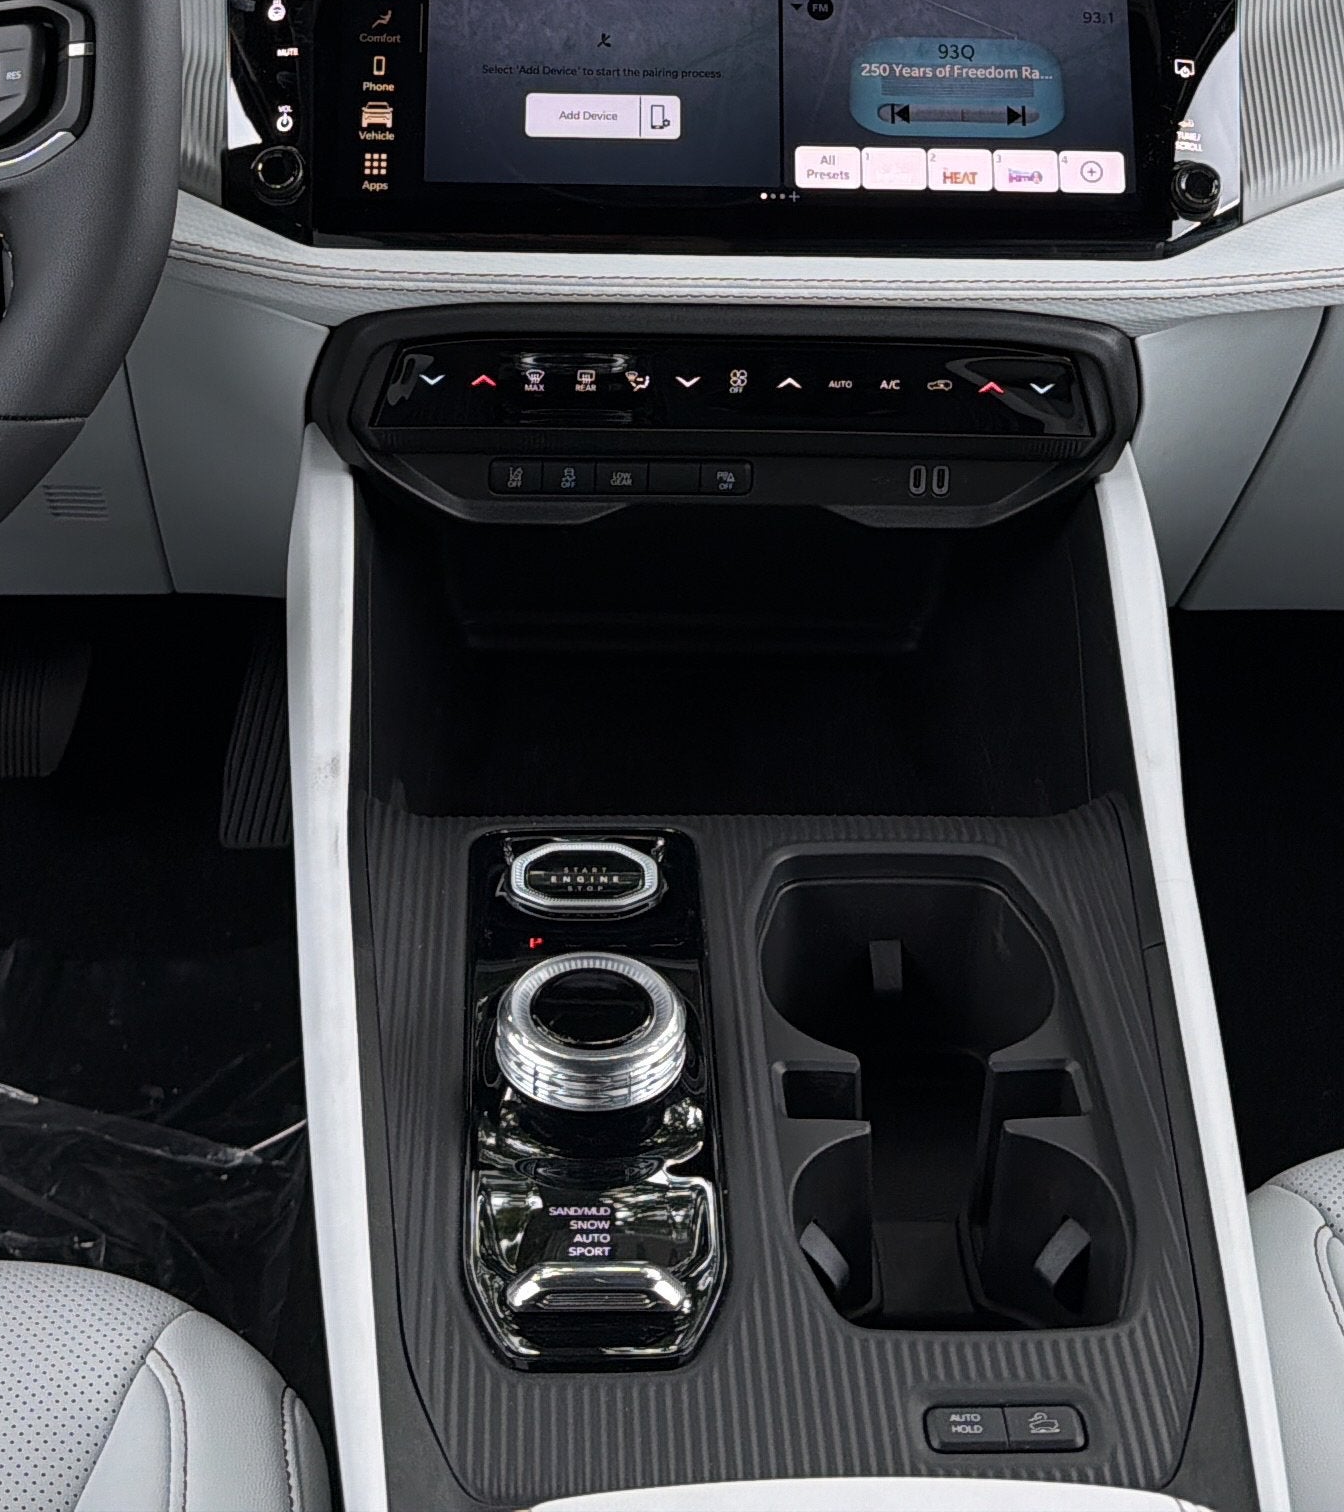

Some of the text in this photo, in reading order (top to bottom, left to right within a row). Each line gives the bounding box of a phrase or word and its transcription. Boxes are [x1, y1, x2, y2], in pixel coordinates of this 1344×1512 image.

[812, 3, 829, 12] FM
[1082, 11, 1114, 24] 93.1
[359, 33, 401, 43] Comfort
[276, 47, 299, 57] MUTE
[938, 44, 976, 62] 93Q
[6, 71, 22, 81] RES
[482, 65, 513, 75] Select
[582, 67, 594, 77] to
[596, 67, 621, 77] start
[623, 67, 641, 77] the
[642, 67, 679, 80] pairing
[860, 63, 890, 77] 250
[892, 64, 933, 78] Years
[936, 64, 951, 78] of
[954, 65, 1019, 79] Freedom
[362, 81, 395, 92] Phone
[278, 105, 293, 113] VOL
[559, 110, 618, 121] Add Device
[358, 130, 395, 141] Vehicle
[820, 154, 836, 166] All
[929, 153, 937, 163] 2
[806, 169, 850, 181] Presets
[942, 171, 978, 185] HEAT
[362, 180, 389, 192] Apps
[524, 384, 545, 392] MAX
[575, 384, 597, 392] REAR
[828, 380, 853, 388] AUTO
[879, 379, 901, 390] A/C
[560, 481, 577, 489] OFF
[610, 478, 633, 486] GEAR
[550, 875, 621, 883] ENGINE
[548, 1206, 611, 1216] SAND/MUD
[569, 1220, 611, 1230] SNOW
[573, 1233, 611, 1243] AUTO
[568, 1246, 612, 1257] SPORT
[949, 1413, 981, 1422] AUTO
[952, 1424, 984, 1434] HOLD
